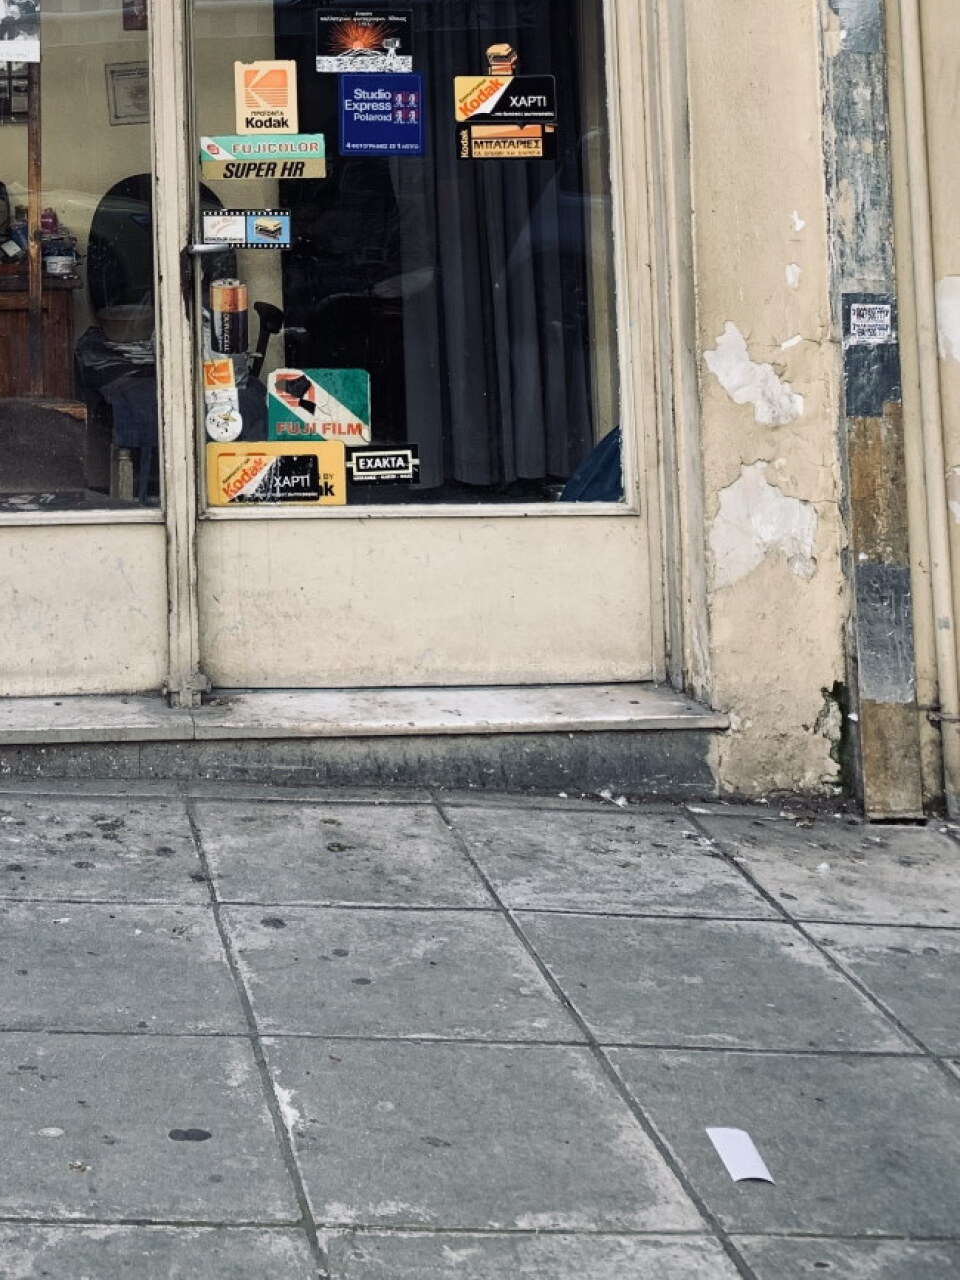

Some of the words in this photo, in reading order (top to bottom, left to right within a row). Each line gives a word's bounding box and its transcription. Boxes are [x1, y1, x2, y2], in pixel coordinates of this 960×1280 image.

[353, 88, 392, 101] Studio
[458, 78, 504, 117] Kodak
[345, 100, 392, 113] Express
[245, 117, 290, 129] Kodak
[353, 113, 392, 122] Polaroid
[232, 142, 319, 154] FUJICOLOR
[460, 128, 469, 158] Kodak
[223, 162, 278, 179] SUPER
[281, 161, 305, 178] HR
[276, 421, 317, 436] FUJI
[322, 422, 363, 436] FILM
[358, 457, 406, 470] EXAKTA
[221, 458, 268, 499] Kodak
